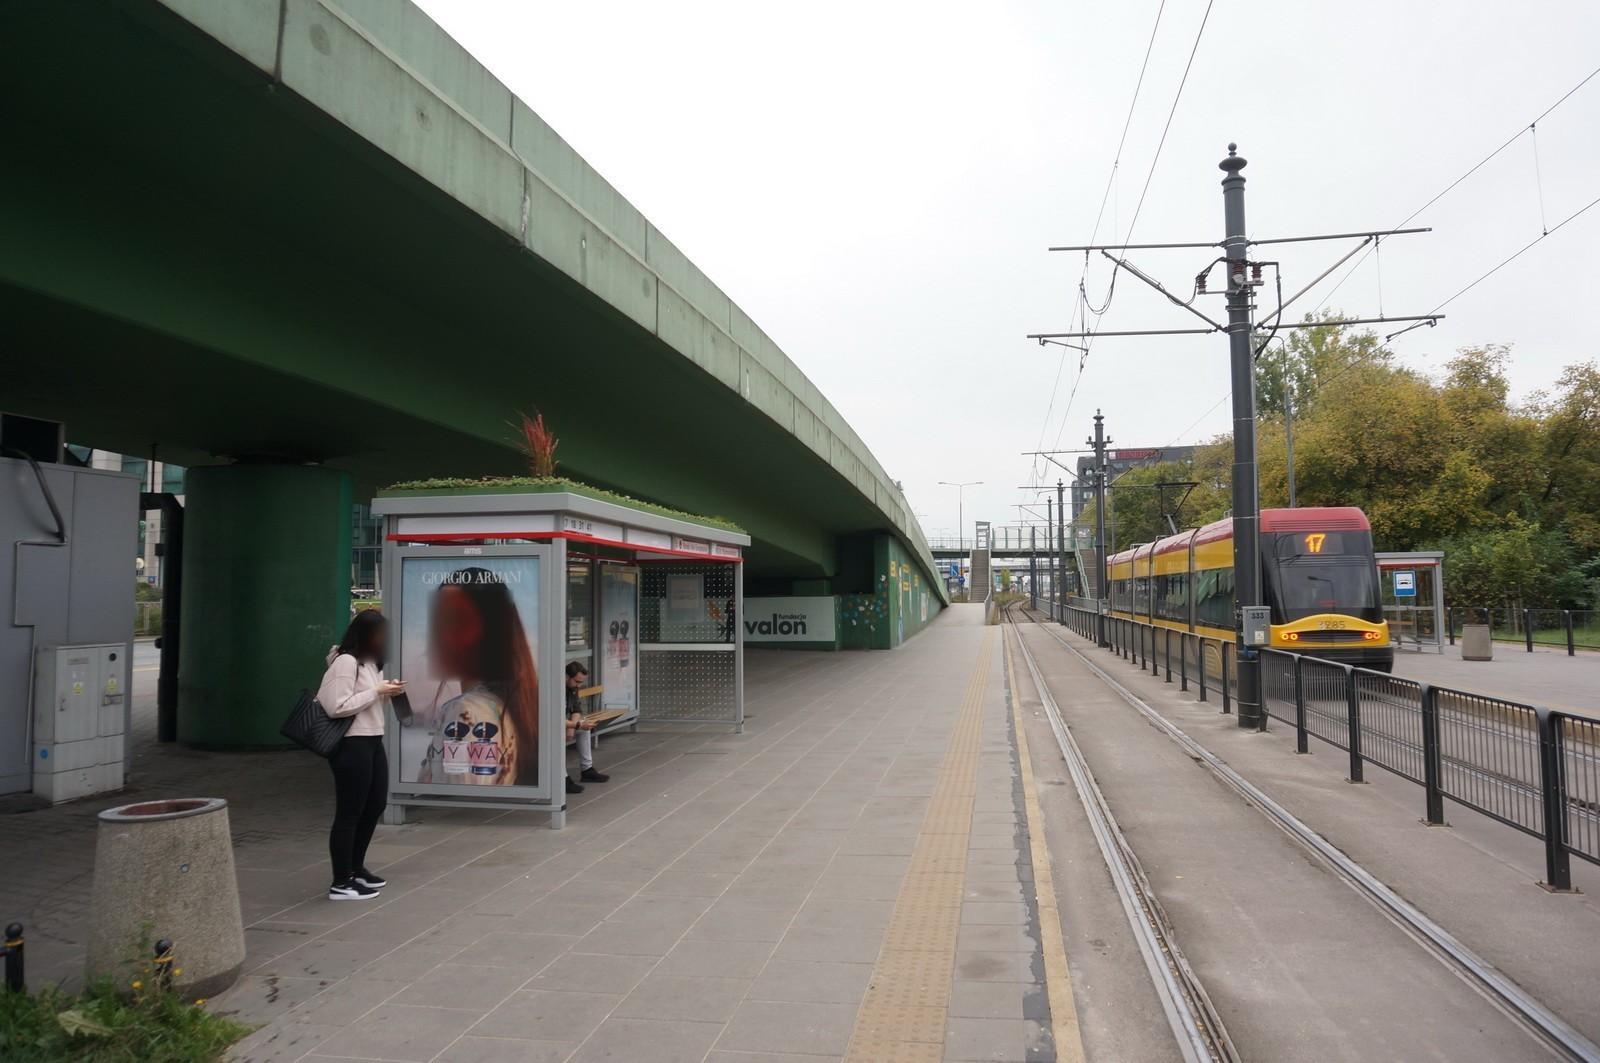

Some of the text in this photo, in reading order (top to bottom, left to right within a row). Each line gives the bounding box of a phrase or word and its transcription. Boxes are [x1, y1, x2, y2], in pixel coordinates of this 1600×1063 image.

[1305, 533, 1327, 553] 17
[422, 571, 522, 584] GIORGIO ARMANI
[432, 746, 508, 761] MY WAY
